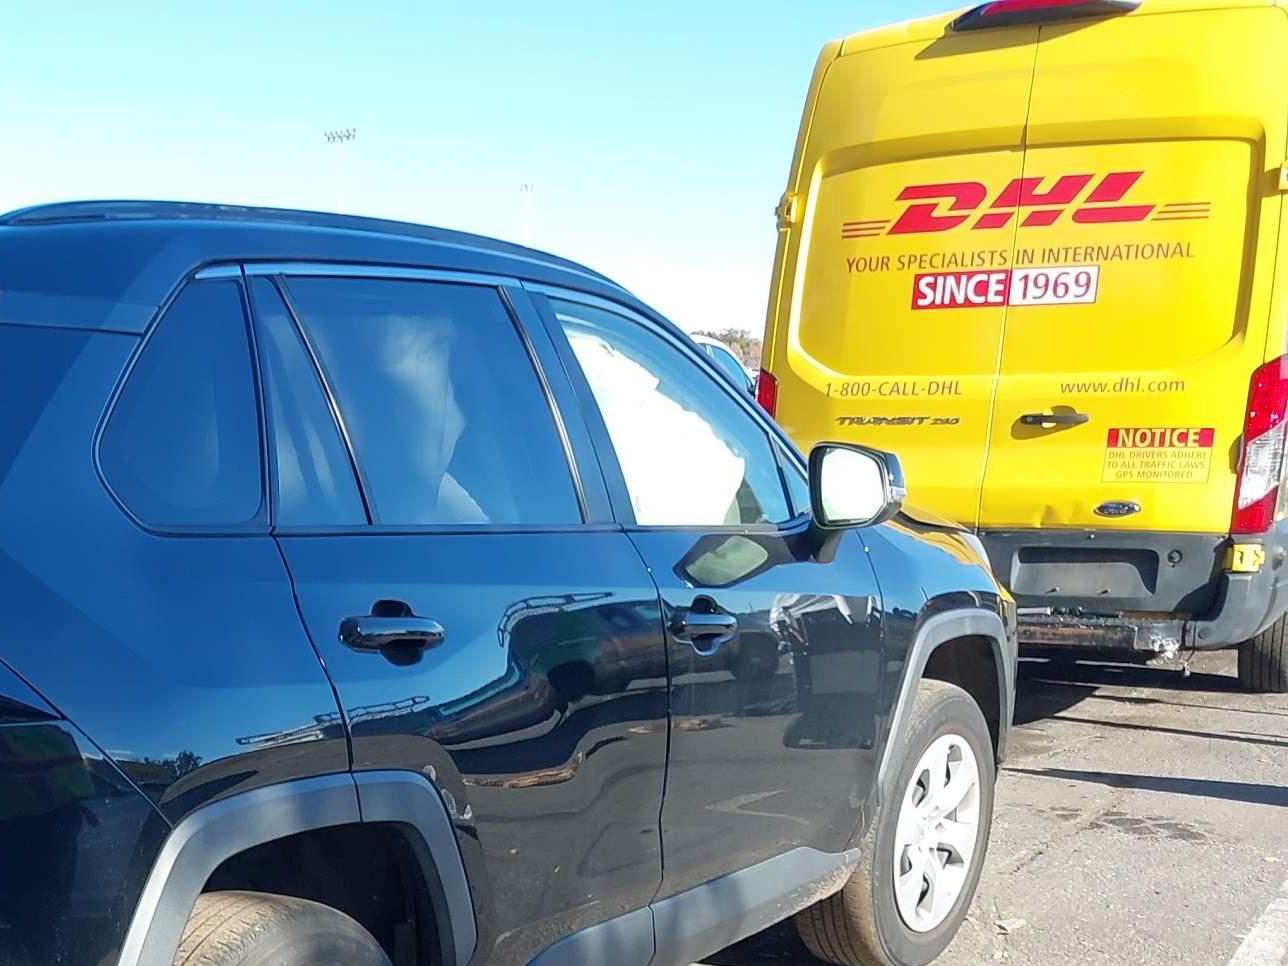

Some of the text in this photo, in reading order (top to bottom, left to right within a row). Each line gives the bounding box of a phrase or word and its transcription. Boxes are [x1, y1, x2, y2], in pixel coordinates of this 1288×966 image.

[886, 171, 1153, 235] DHL
[846, 241, 1194, 273] YOUR SPECIALISTS IN INTERNATIONAL
[916, 270, 1092, 307] SINCE 1969
[825, 380, 963, 397] 1-800-CALL-DHL
[1060, 377, 1185, 393] www.dhl.com
[1117, 428, 1201, 448] NOTICE
[1108, 450, 1208, 460] DHL DRIVERS ADHERE
[1108, 460, 1205, 469] TO ALL TRAFFIC LAWS
[1115, 470, 1193, 479] GPS MONITORED
